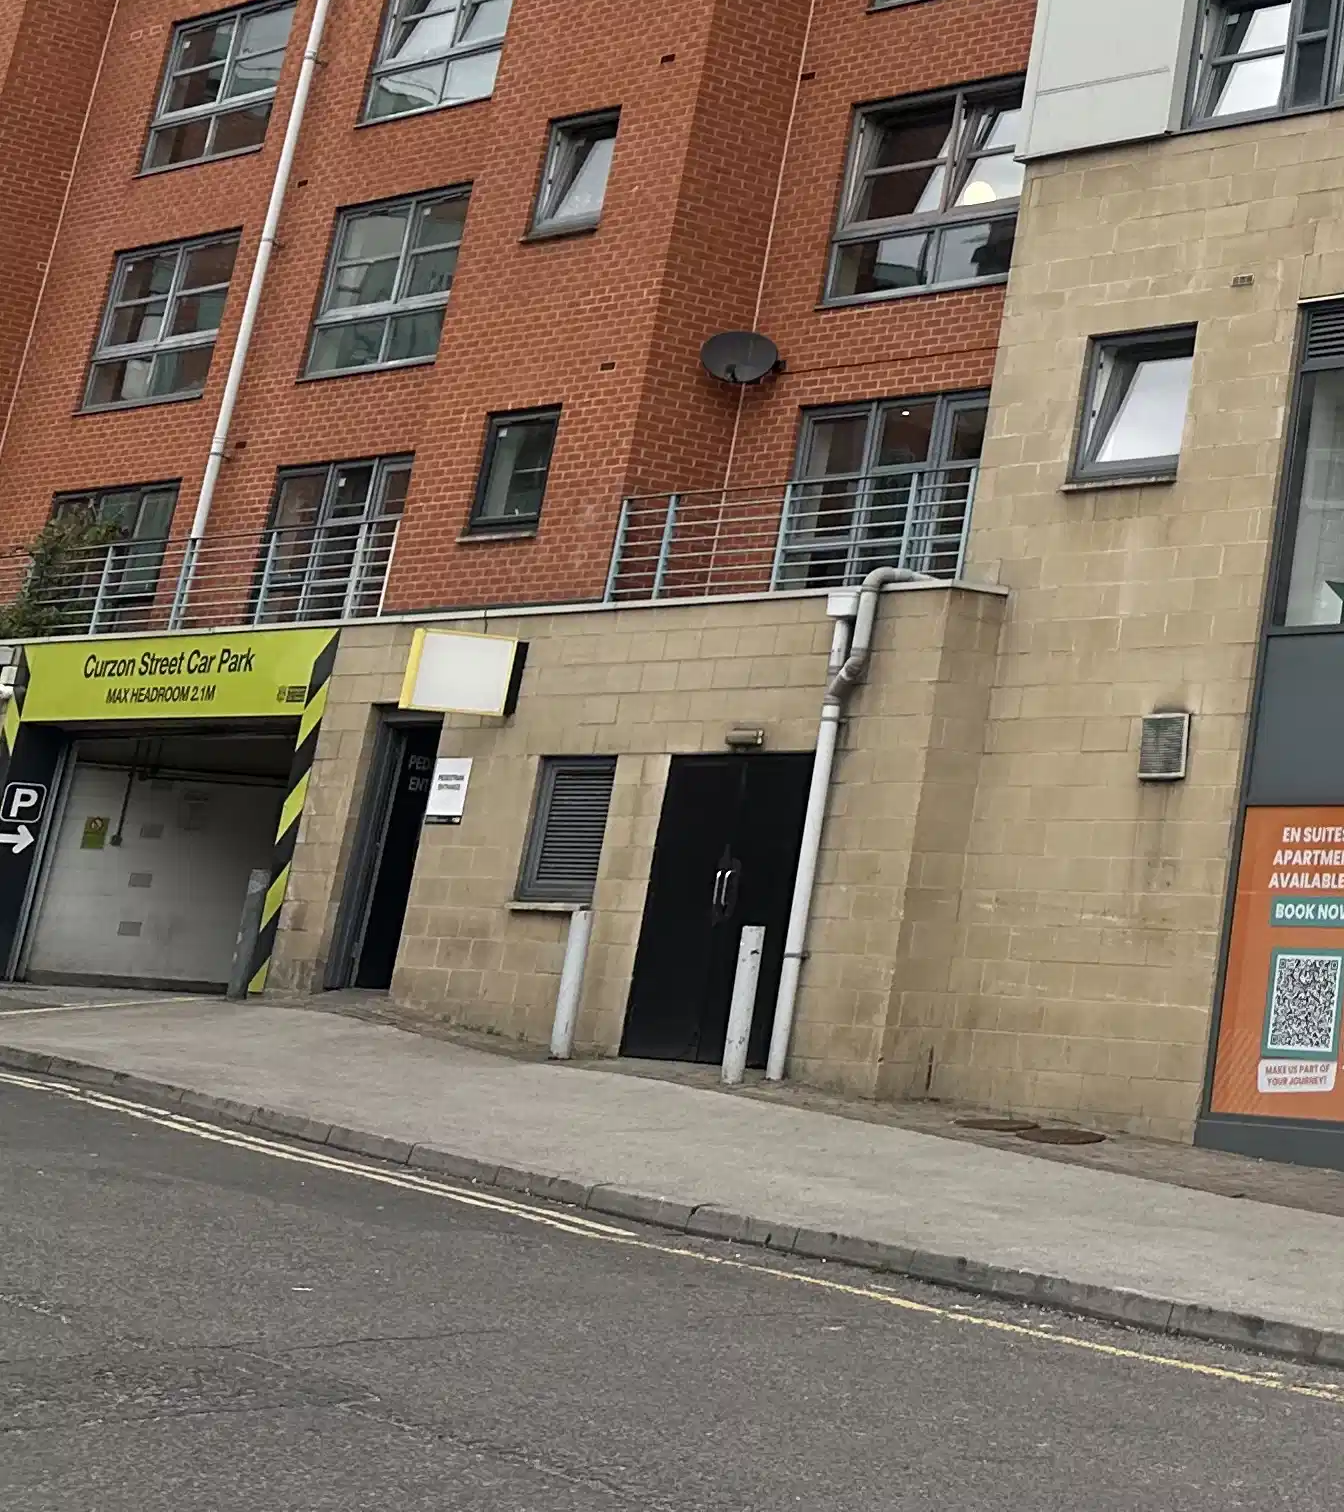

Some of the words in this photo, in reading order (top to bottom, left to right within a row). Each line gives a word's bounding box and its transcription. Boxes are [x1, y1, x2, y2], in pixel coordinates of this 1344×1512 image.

[83, 654, 136, 679] Curzon
[138, 651, 184, 676] Street
[186, 649, 217, 675] Car
[217, 647, 257, 673] Park
[105, 688, 130, 704] MAX
[130, 686, 191, 704] HEADROOM
[190, 685, 217, 702] 2.1M
[9, 788, 39, 818] P
[1282, 827, 1301, 843] EN
[1275, 903, 1316, 920] BOOK
[1265, 1065, 1287, 1074] MAKE
[1288, 1064, 1298, 1074] US
[1299, 1064, 1319, 1073] PART
[1319, 1063, 1330, 1073] OF
[1267, 1077, 1288, 1086] YOUR
